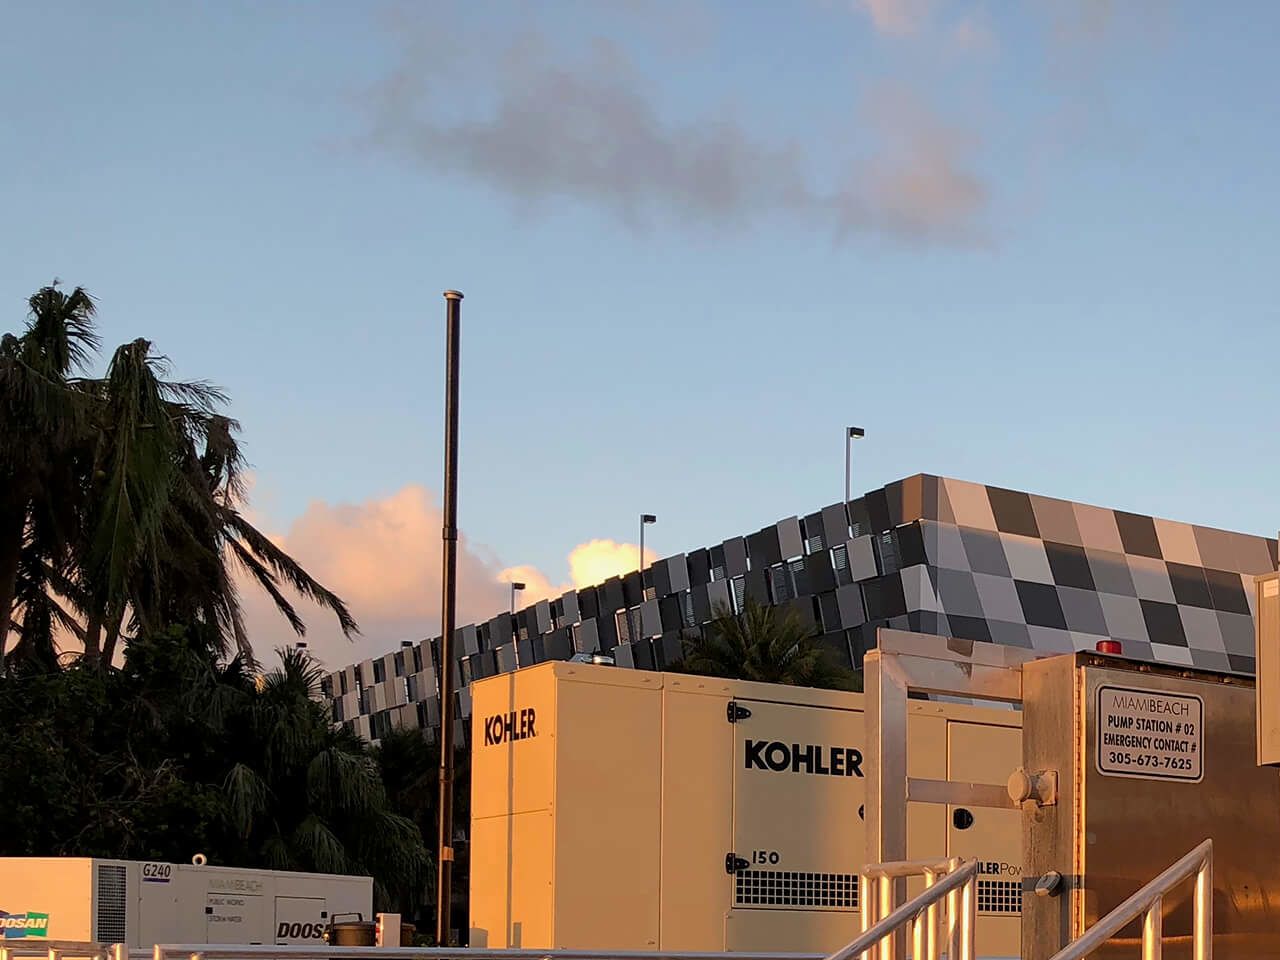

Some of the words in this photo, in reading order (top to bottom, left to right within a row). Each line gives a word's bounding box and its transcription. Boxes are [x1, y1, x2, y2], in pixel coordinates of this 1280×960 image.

[484, 708, 537, 747] KOHLER
[1108, 715, 1134, 729] PUMP
[1136, 718, 1173, 733] STATION
[1175, 723, 1182, 734] #
[1184, 723, 1195, 736] 02
[1103, 733, 1152, 749] EMERGENCY
[1154, 738, 1189, 753] CONTACT
[1190, 742, 1197, 753] #
[744, 740, 864, 777] KOHLER
[1109, 752, 1192, 770] 305-673-7625
[752, 851, 780, 864] 150
[143, 863, 171, 877] G240
[277, 922, 325, 939] DOOS
